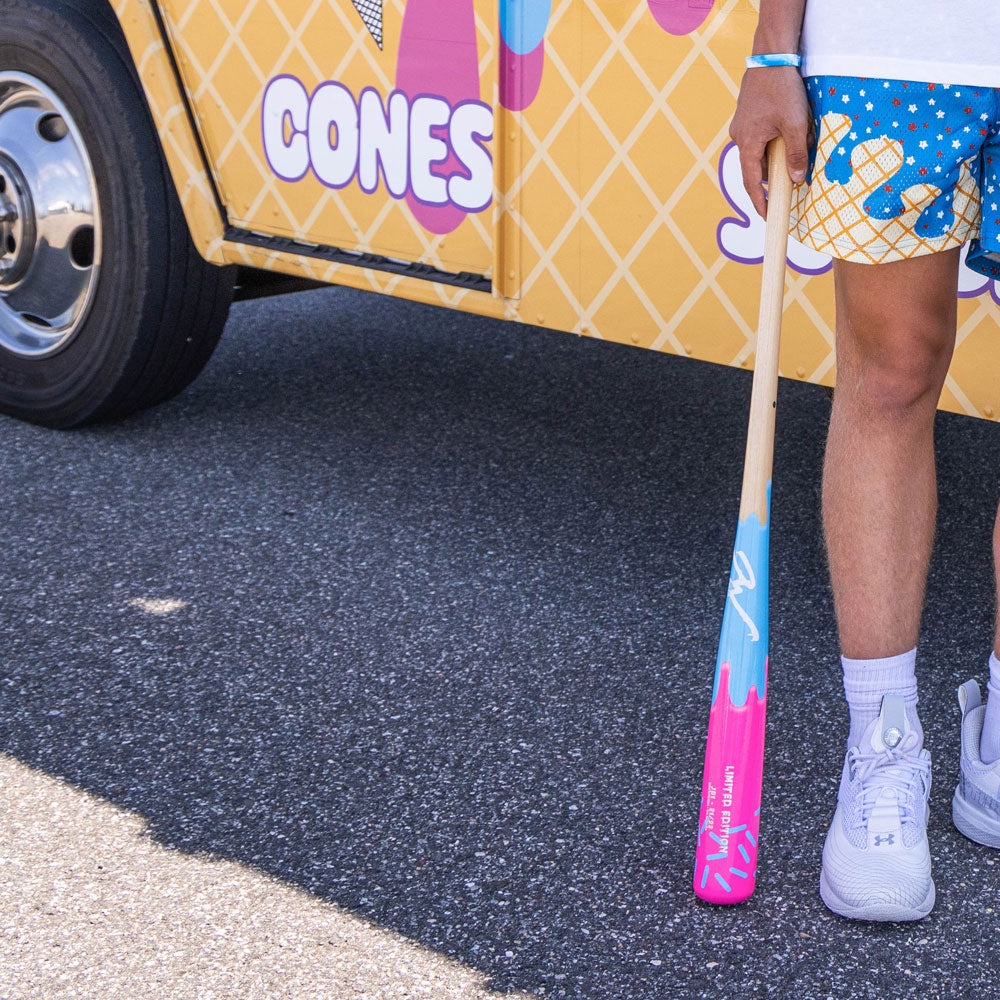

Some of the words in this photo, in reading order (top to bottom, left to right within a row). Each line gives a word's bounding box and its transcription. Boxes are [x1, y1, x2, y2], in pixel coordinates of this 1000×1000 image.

[261, 73, 493, 214] CONES
[722, 765, 735, 807] LIMITED
[718, 810, 731, 855] EDITION
